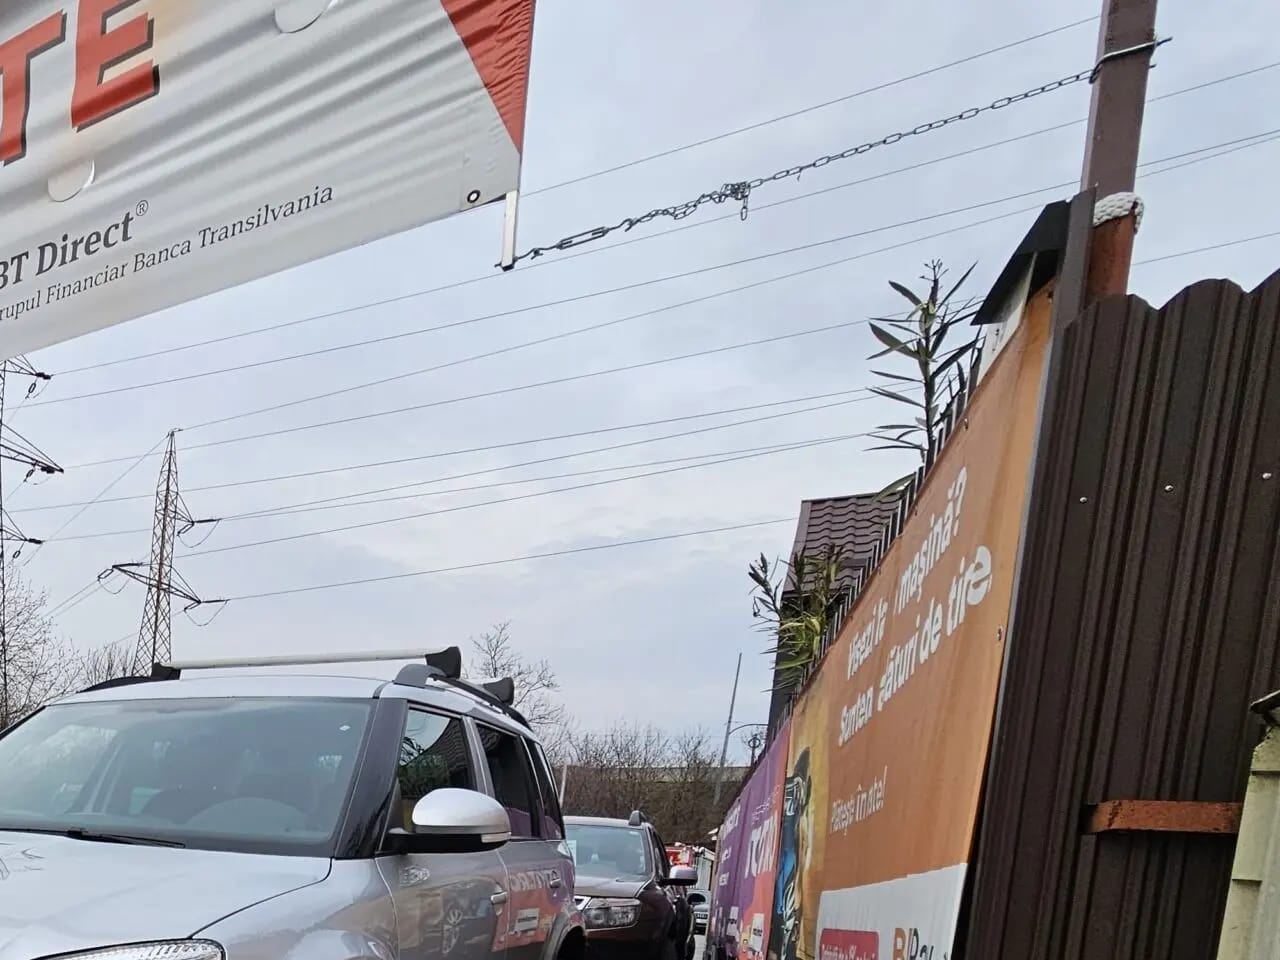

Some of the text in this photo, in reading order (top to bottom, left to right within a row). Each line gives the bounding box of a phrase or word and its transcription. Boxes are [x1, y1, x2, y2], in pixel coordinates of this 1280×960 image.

[45, 262, 128, 306] Financiar
[133, 239, 192, 273] Banca
[198, 184, 334, 249] Transilvania
